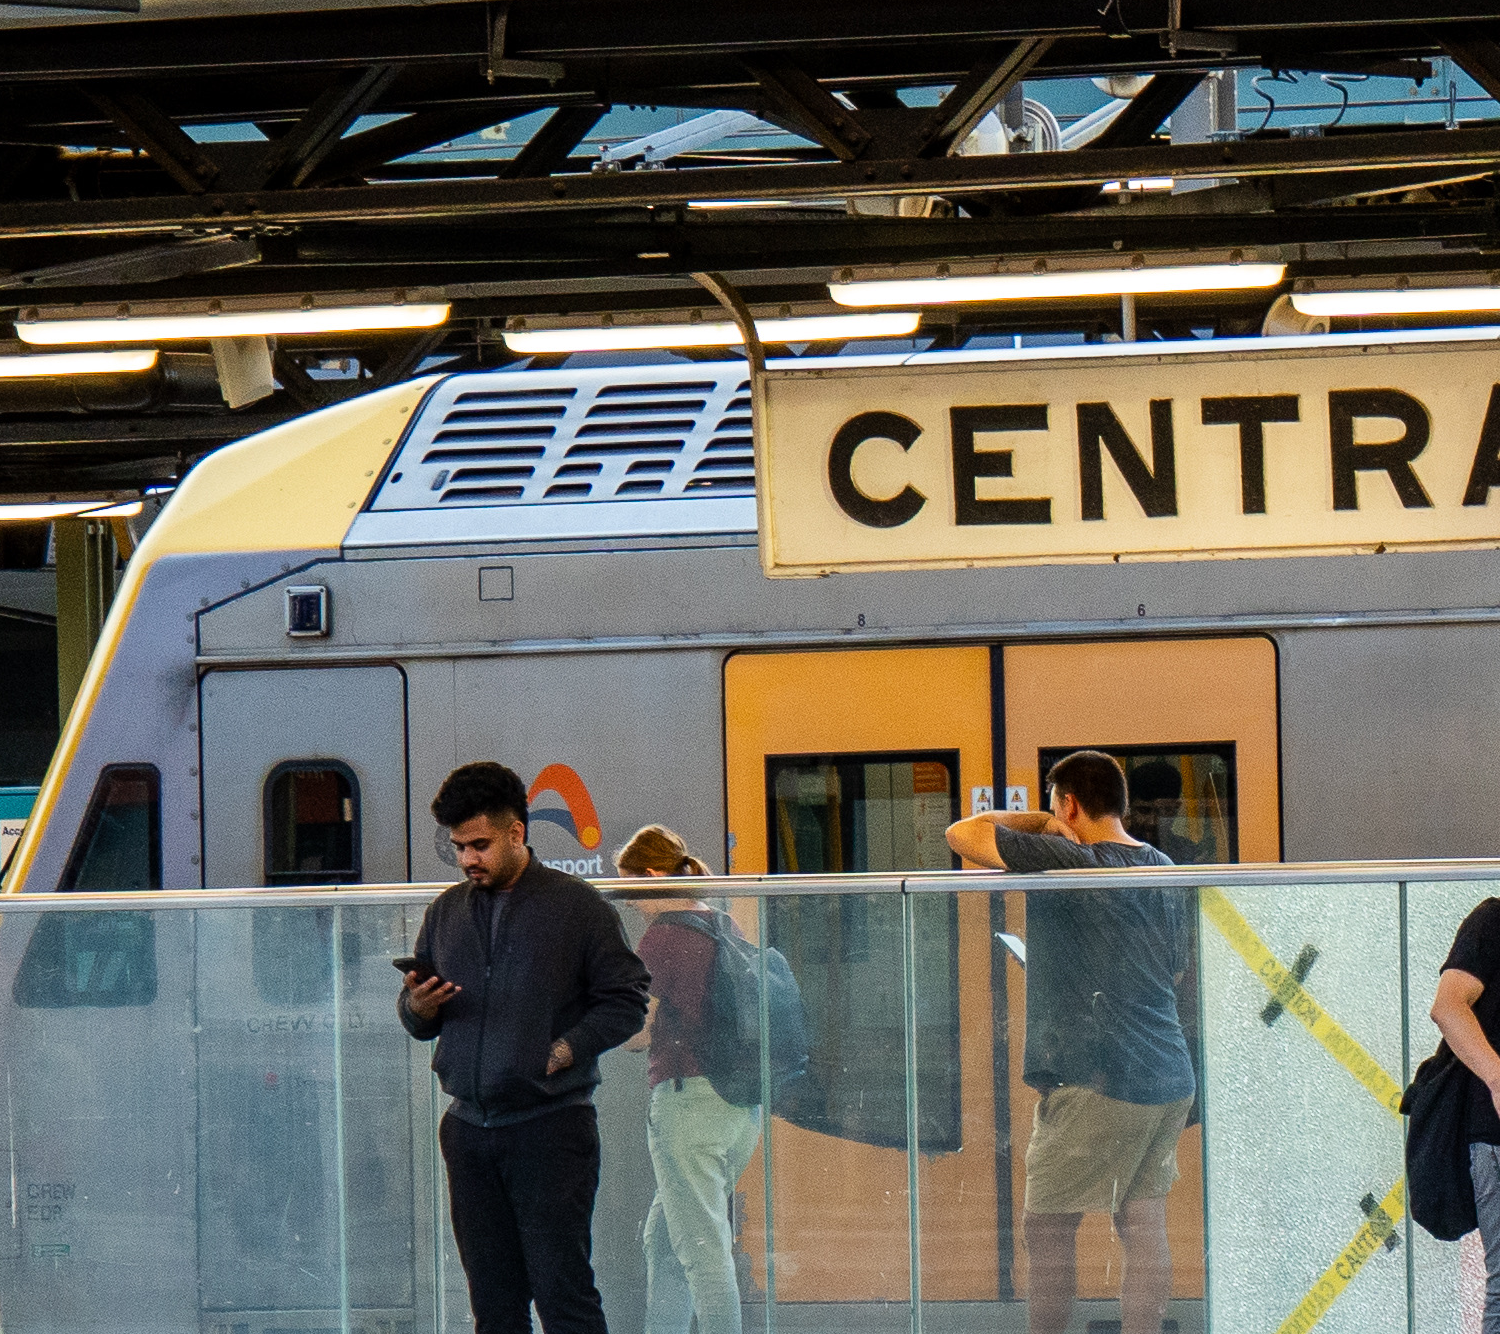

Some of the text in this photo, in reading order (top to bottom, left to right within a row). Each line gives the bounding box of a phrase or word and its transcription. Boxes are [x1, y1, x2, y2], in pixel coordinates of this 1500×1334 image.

[1137, 604, 1146, 617] 6
[857, 613, 866, 627] 8
[2, 826, 24, 836] Acc
[323, 1011, 368, 1033] OLY
